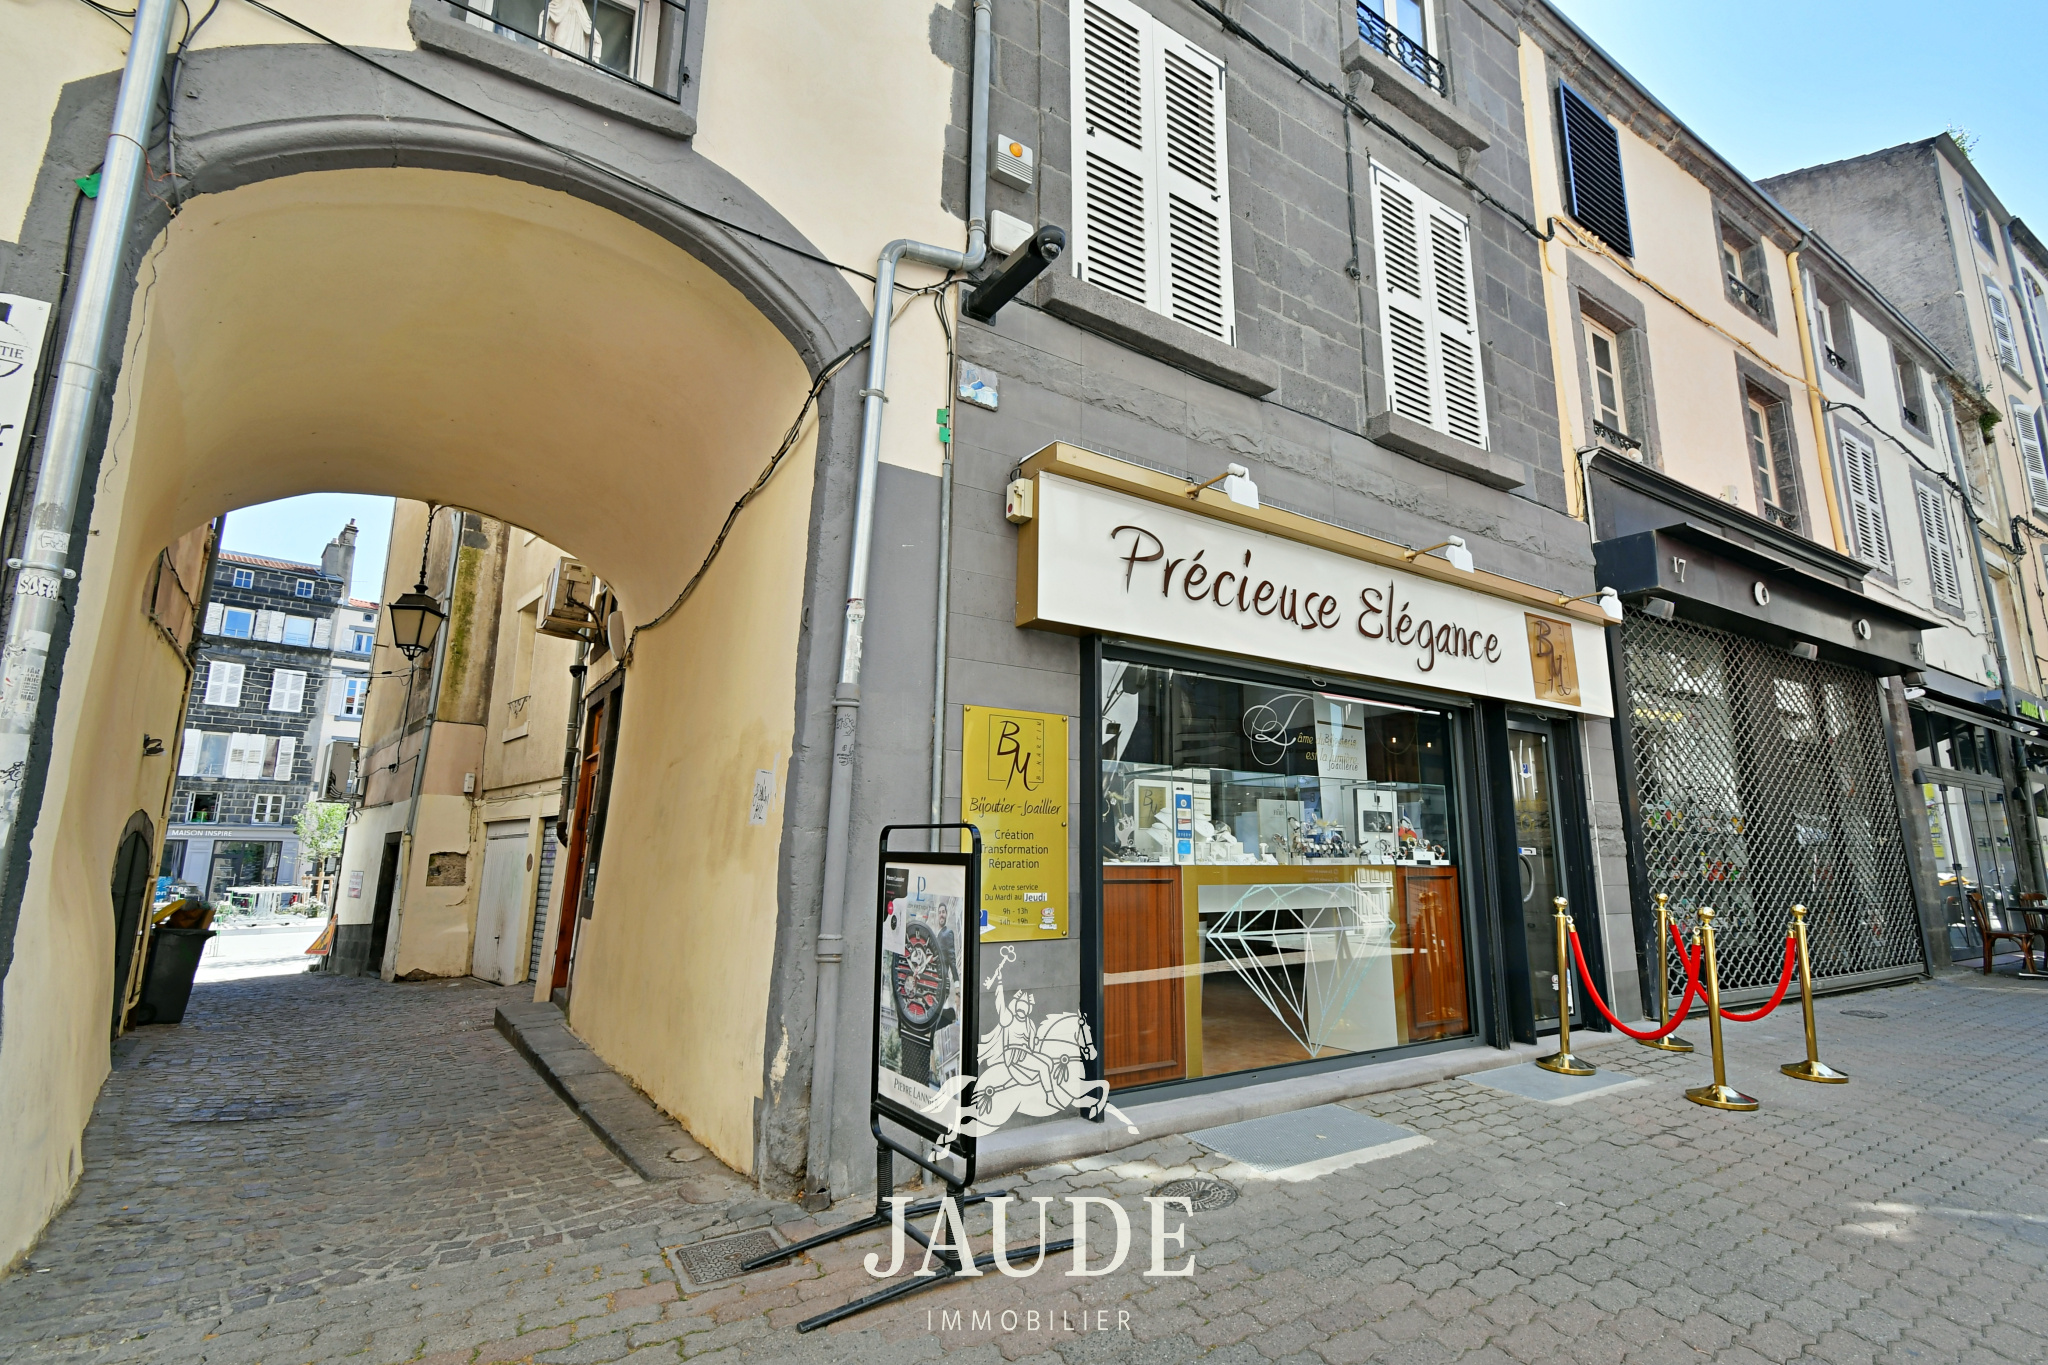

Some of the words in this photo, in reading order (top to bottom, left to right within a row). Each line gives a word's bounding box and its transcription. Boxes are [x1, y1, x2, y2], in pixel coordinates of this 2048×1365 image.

[1672, 556, 1687, 583] 17
[17, 575, 59, 599] SOFA
[1111, 525, 1341, 630] Précieuse
[1358, 579, 1502, 672] Elégance
[997, 720, 1039, 792] BM
[994, 829, 1034, 840] Création
[981, 844, 1049, 854] Transformation
[988, 858, 1040, 870] Réparation
[1024, 893, 1046, 901] Jeudi
[1017, 917, 1029, 925] 19h
[893, 1077, 912, 1097] PIERRE
